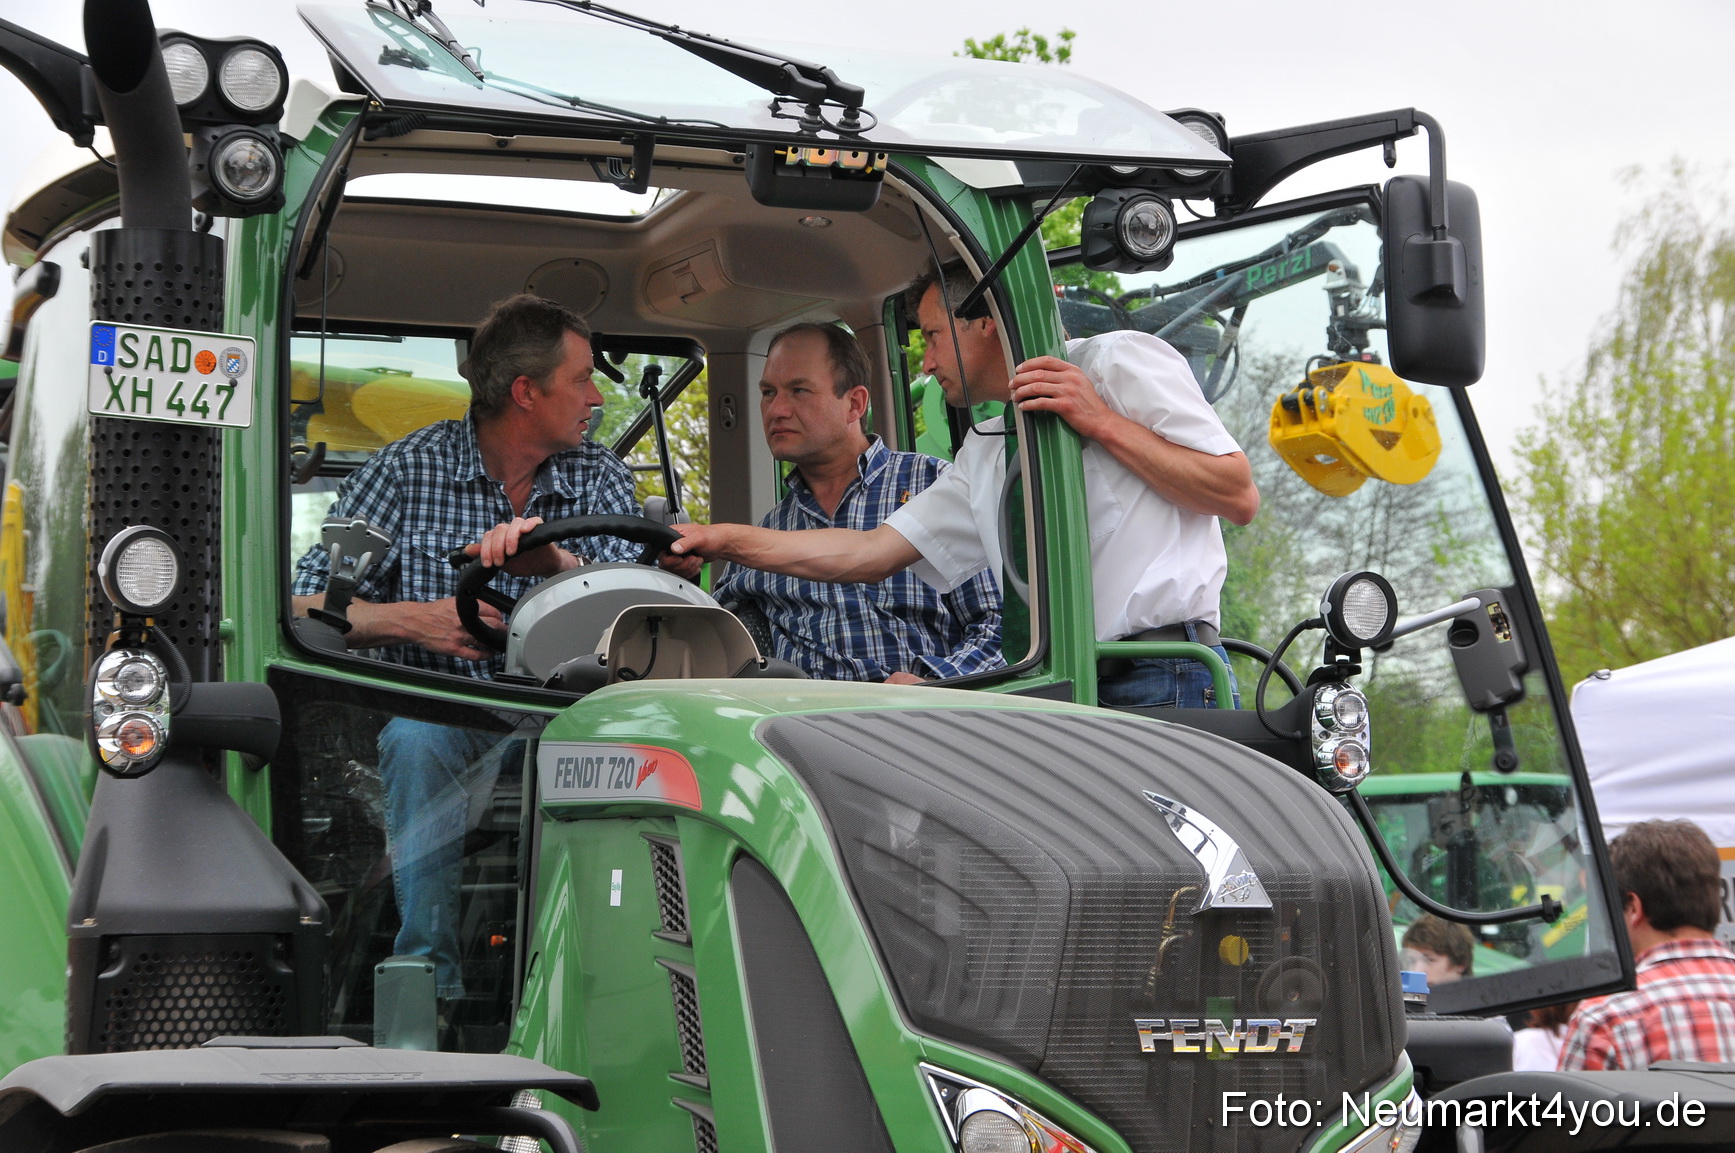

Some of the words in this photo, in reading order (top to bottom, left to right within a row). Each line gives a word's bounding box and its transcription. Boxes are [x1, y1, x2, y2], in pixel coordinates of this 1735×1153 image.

[1247, 247, 1312, 291] Perzl
[97, 350, 108, 363] D
[118, 332, 192, 373] SAD
[104, 375, 153, 414] XH
[165, 380, 234, 420] 447
[554, 756, 604, 789] FENDT
[607, 756, 635, 789] 720
[1134, 1018, 1317, 1053] FENDT
